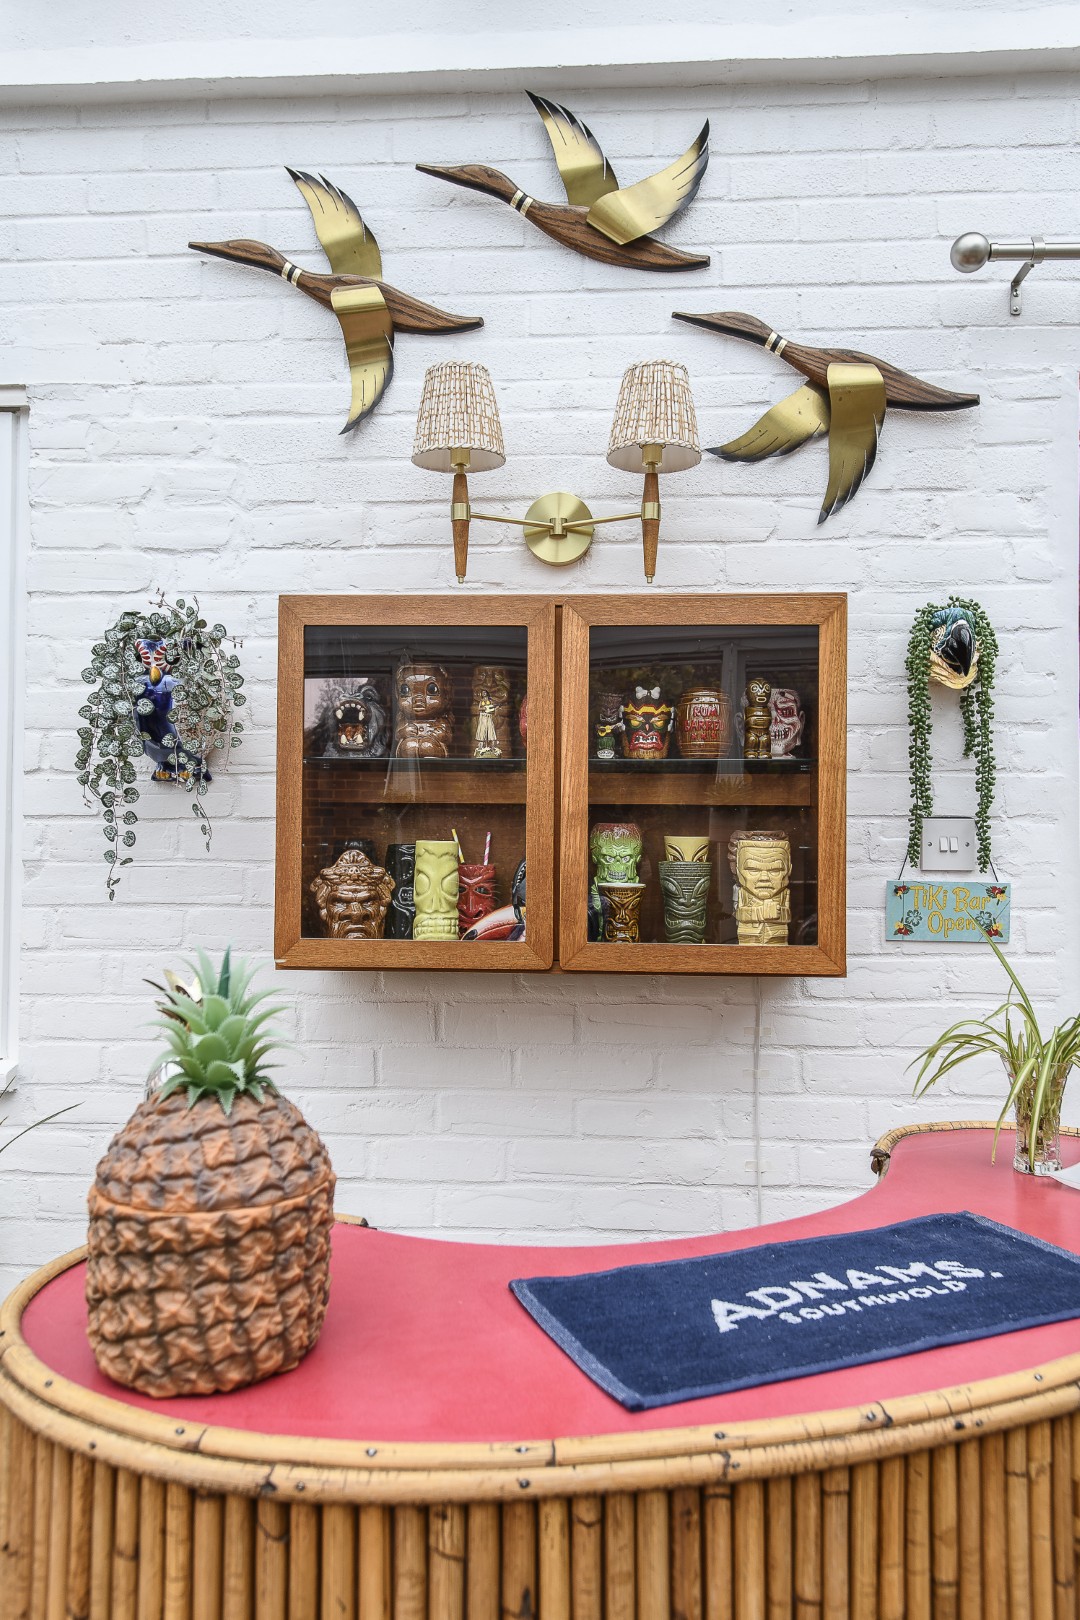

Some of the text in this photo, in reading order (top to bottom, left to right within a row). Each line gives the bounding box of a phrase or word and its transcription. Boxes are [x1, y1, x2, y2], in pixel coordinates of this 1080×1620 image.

[693, 705, 718, 717] RUM
[684, 719, 724, 731] BARREL
[952, 886, 991, 913] Bar
[927, 910, 977, 938] Open
[779, 1280, 968, 1324] SOUTHWOLD
